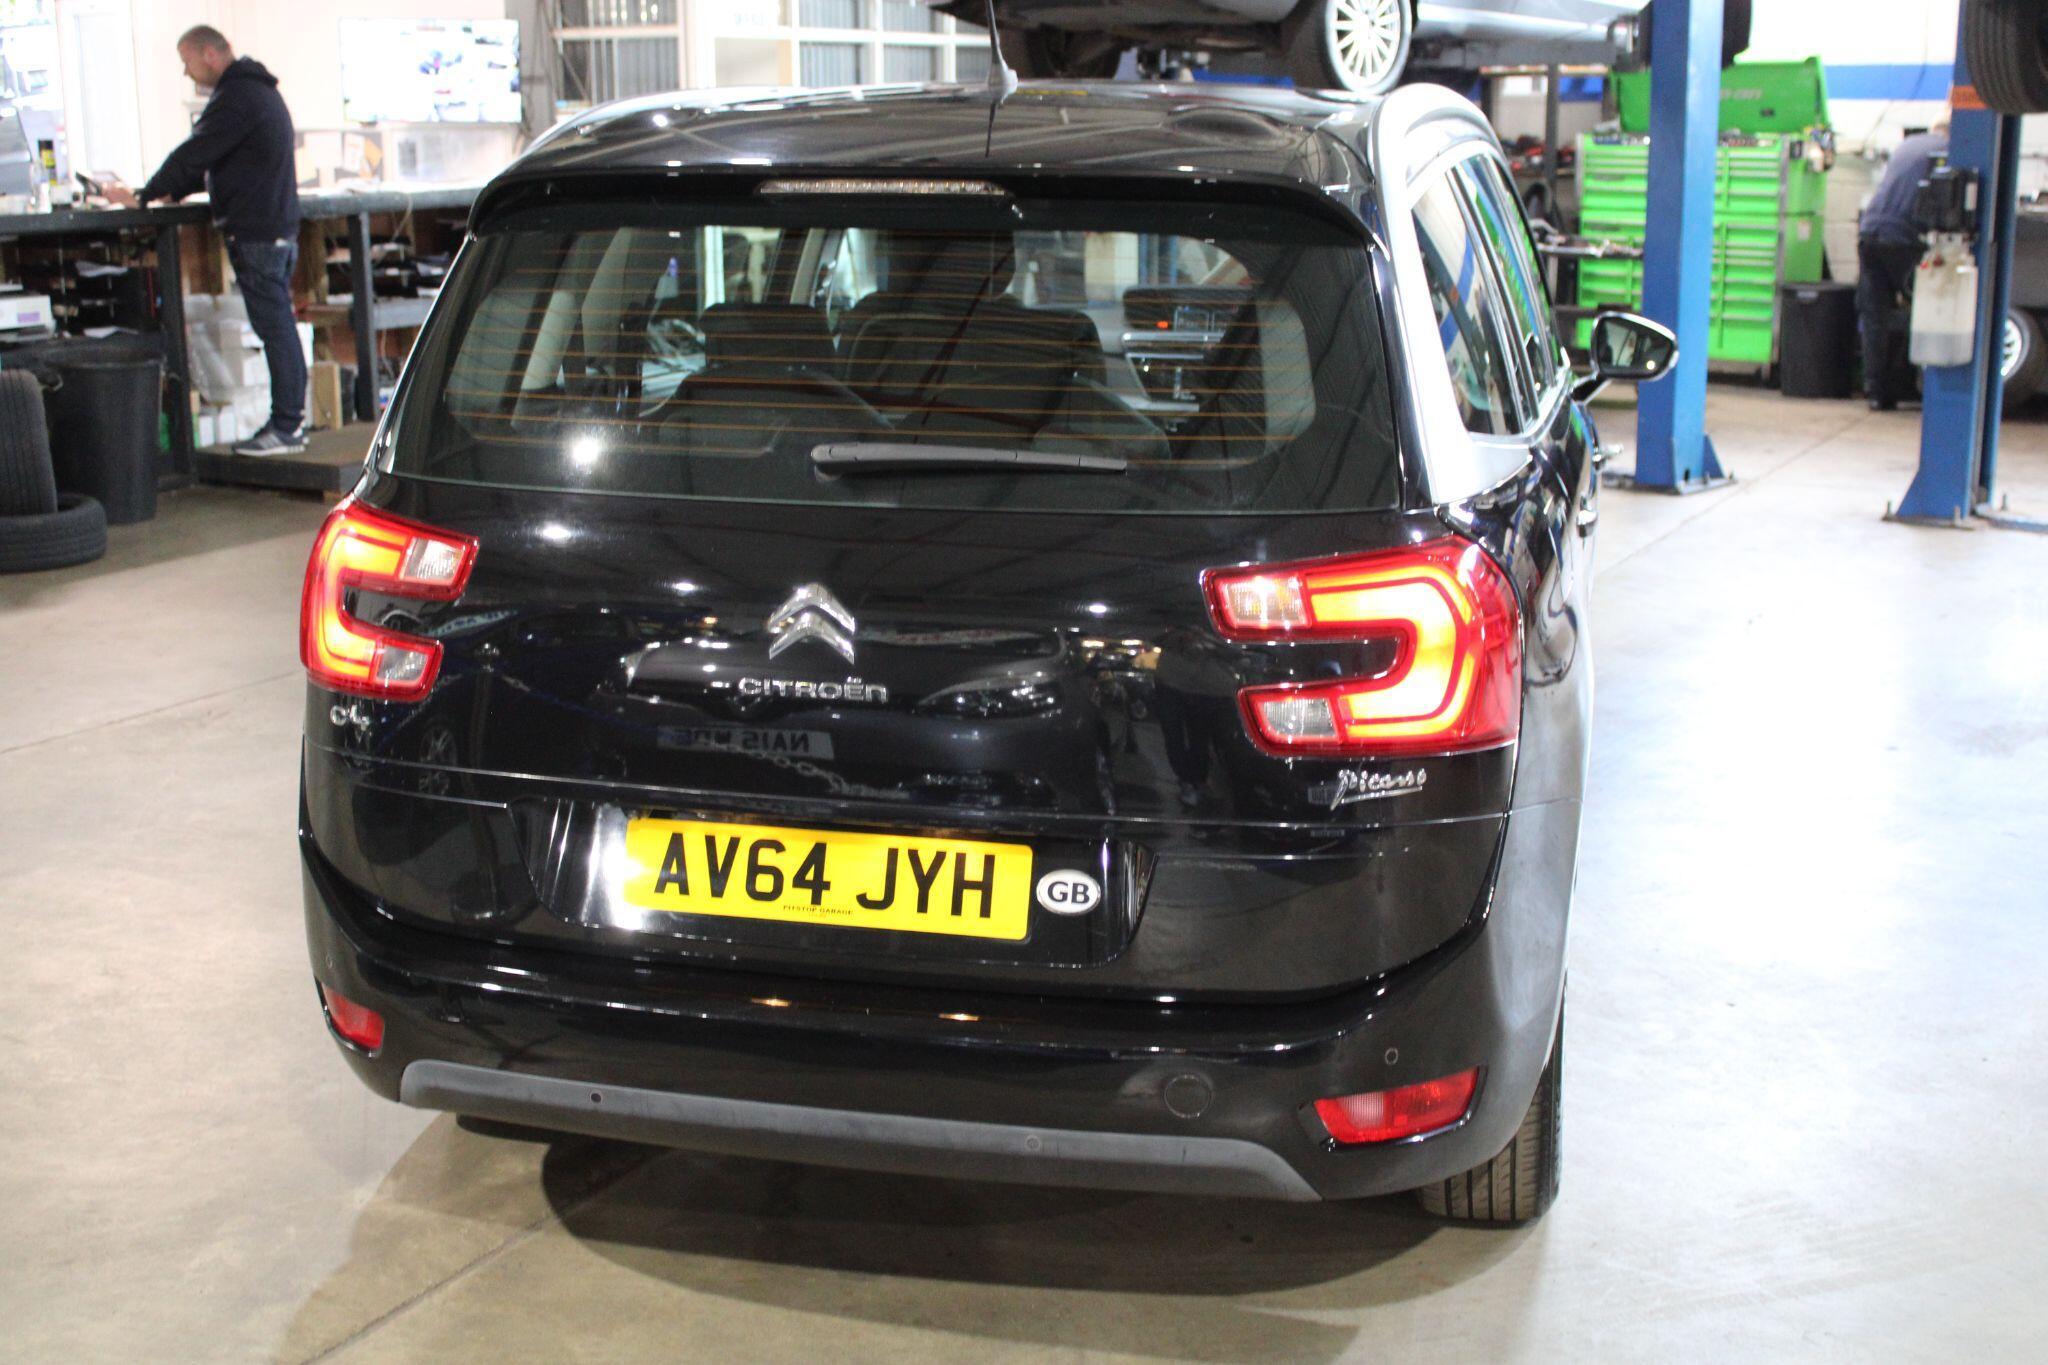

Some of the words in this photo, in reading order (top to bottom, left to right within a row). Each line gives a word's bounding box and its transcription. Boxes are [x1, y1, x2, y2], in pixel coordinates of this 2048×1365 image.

[330, 704, 370, 732] C4
[1330, 768, 1427, 811] Picasso
[654, 832, 831, 906] AV64
[856, 848, 996, 918] JYH
[1047, 881, 1090, 904] GB
[783, 904, 817, 913] PITSTOP
[819, 907, 853, 916] GARAGE
